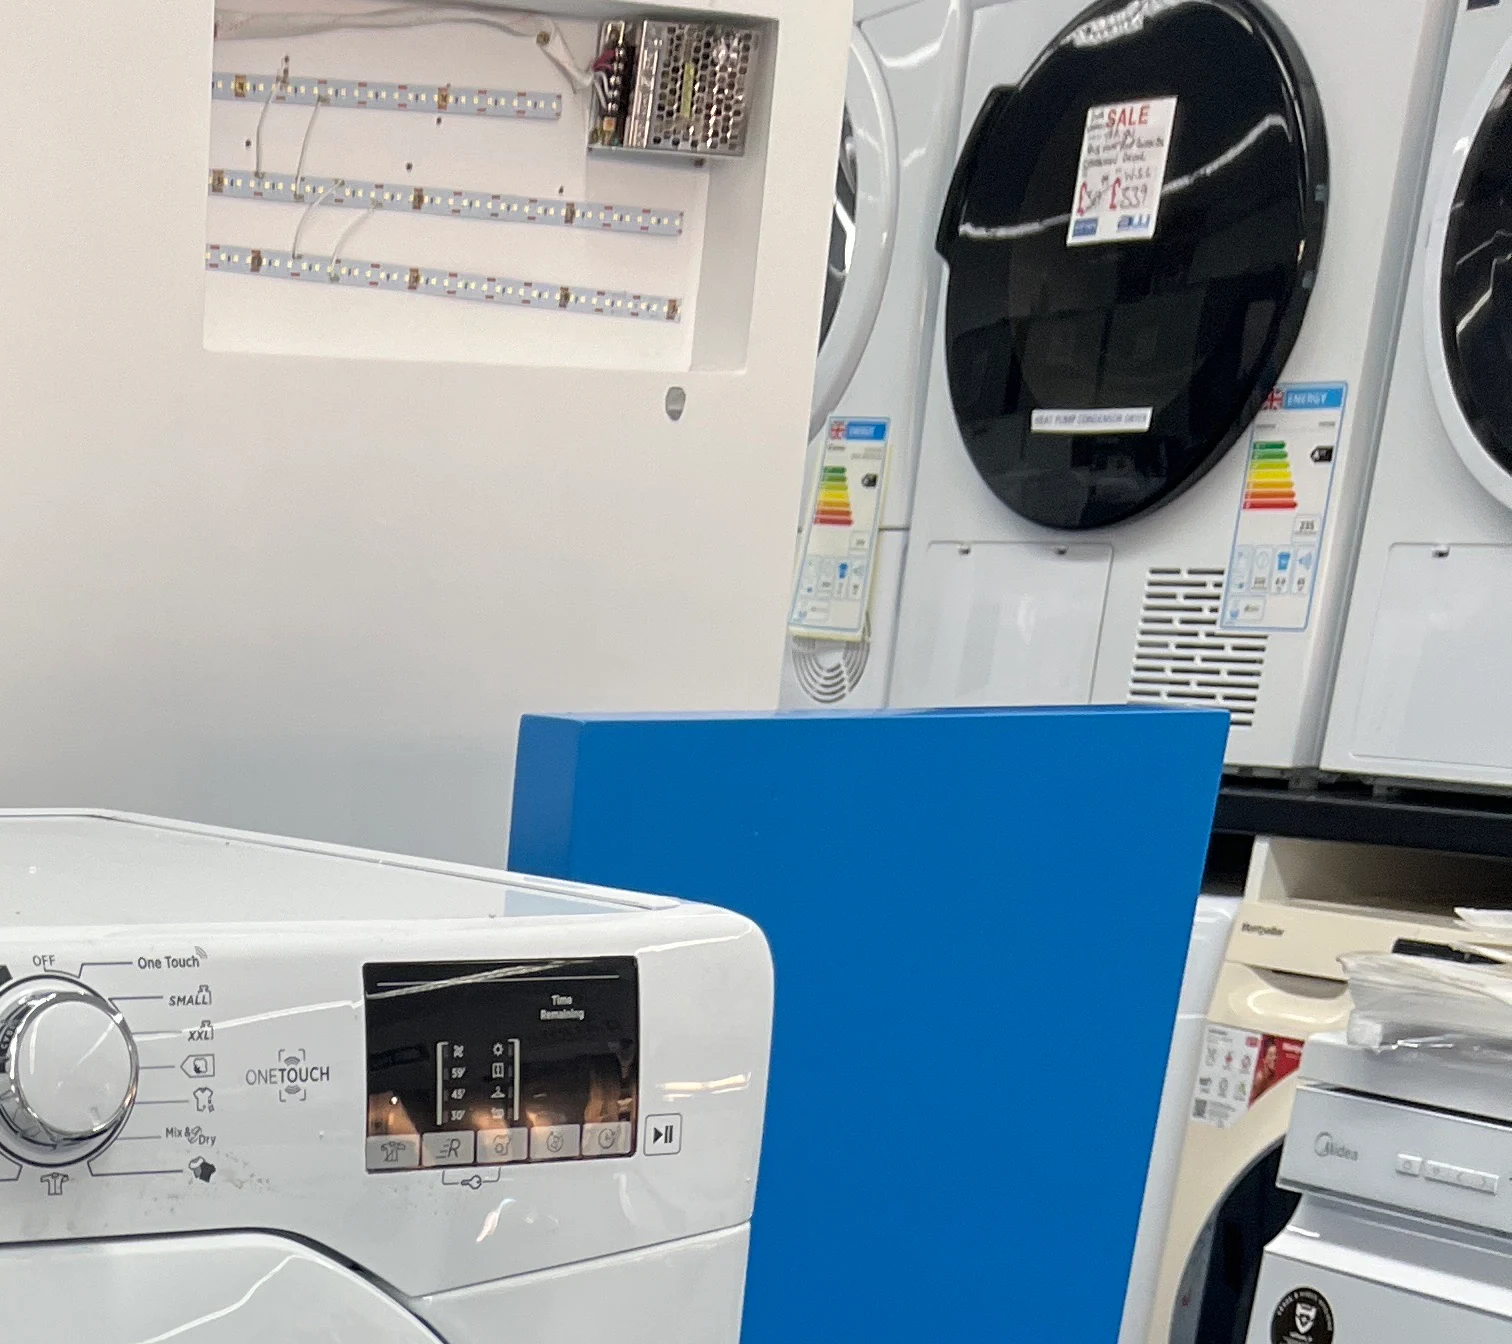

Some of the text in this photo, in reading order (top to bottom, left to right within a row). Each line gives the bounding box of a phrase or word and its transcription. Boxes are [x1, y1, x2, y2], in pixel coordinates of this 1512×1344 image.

[1106, 104, 1150, 128] SALE
[1287, 391, 1327, 405] ENERGY
[32, 954, 56, 967] OFF
[137, 954, 200, 970] One Touch
[168, 991, 209, 1007] SMALL
[551, 994, 573, 1007] Time
[540, 1007, 585, 1021] Remaining
[187, 1028, 210, 1042] XXL
[165, 1127, 183, 1138] Mix
[198, 1134, 216, 1146] Dry
